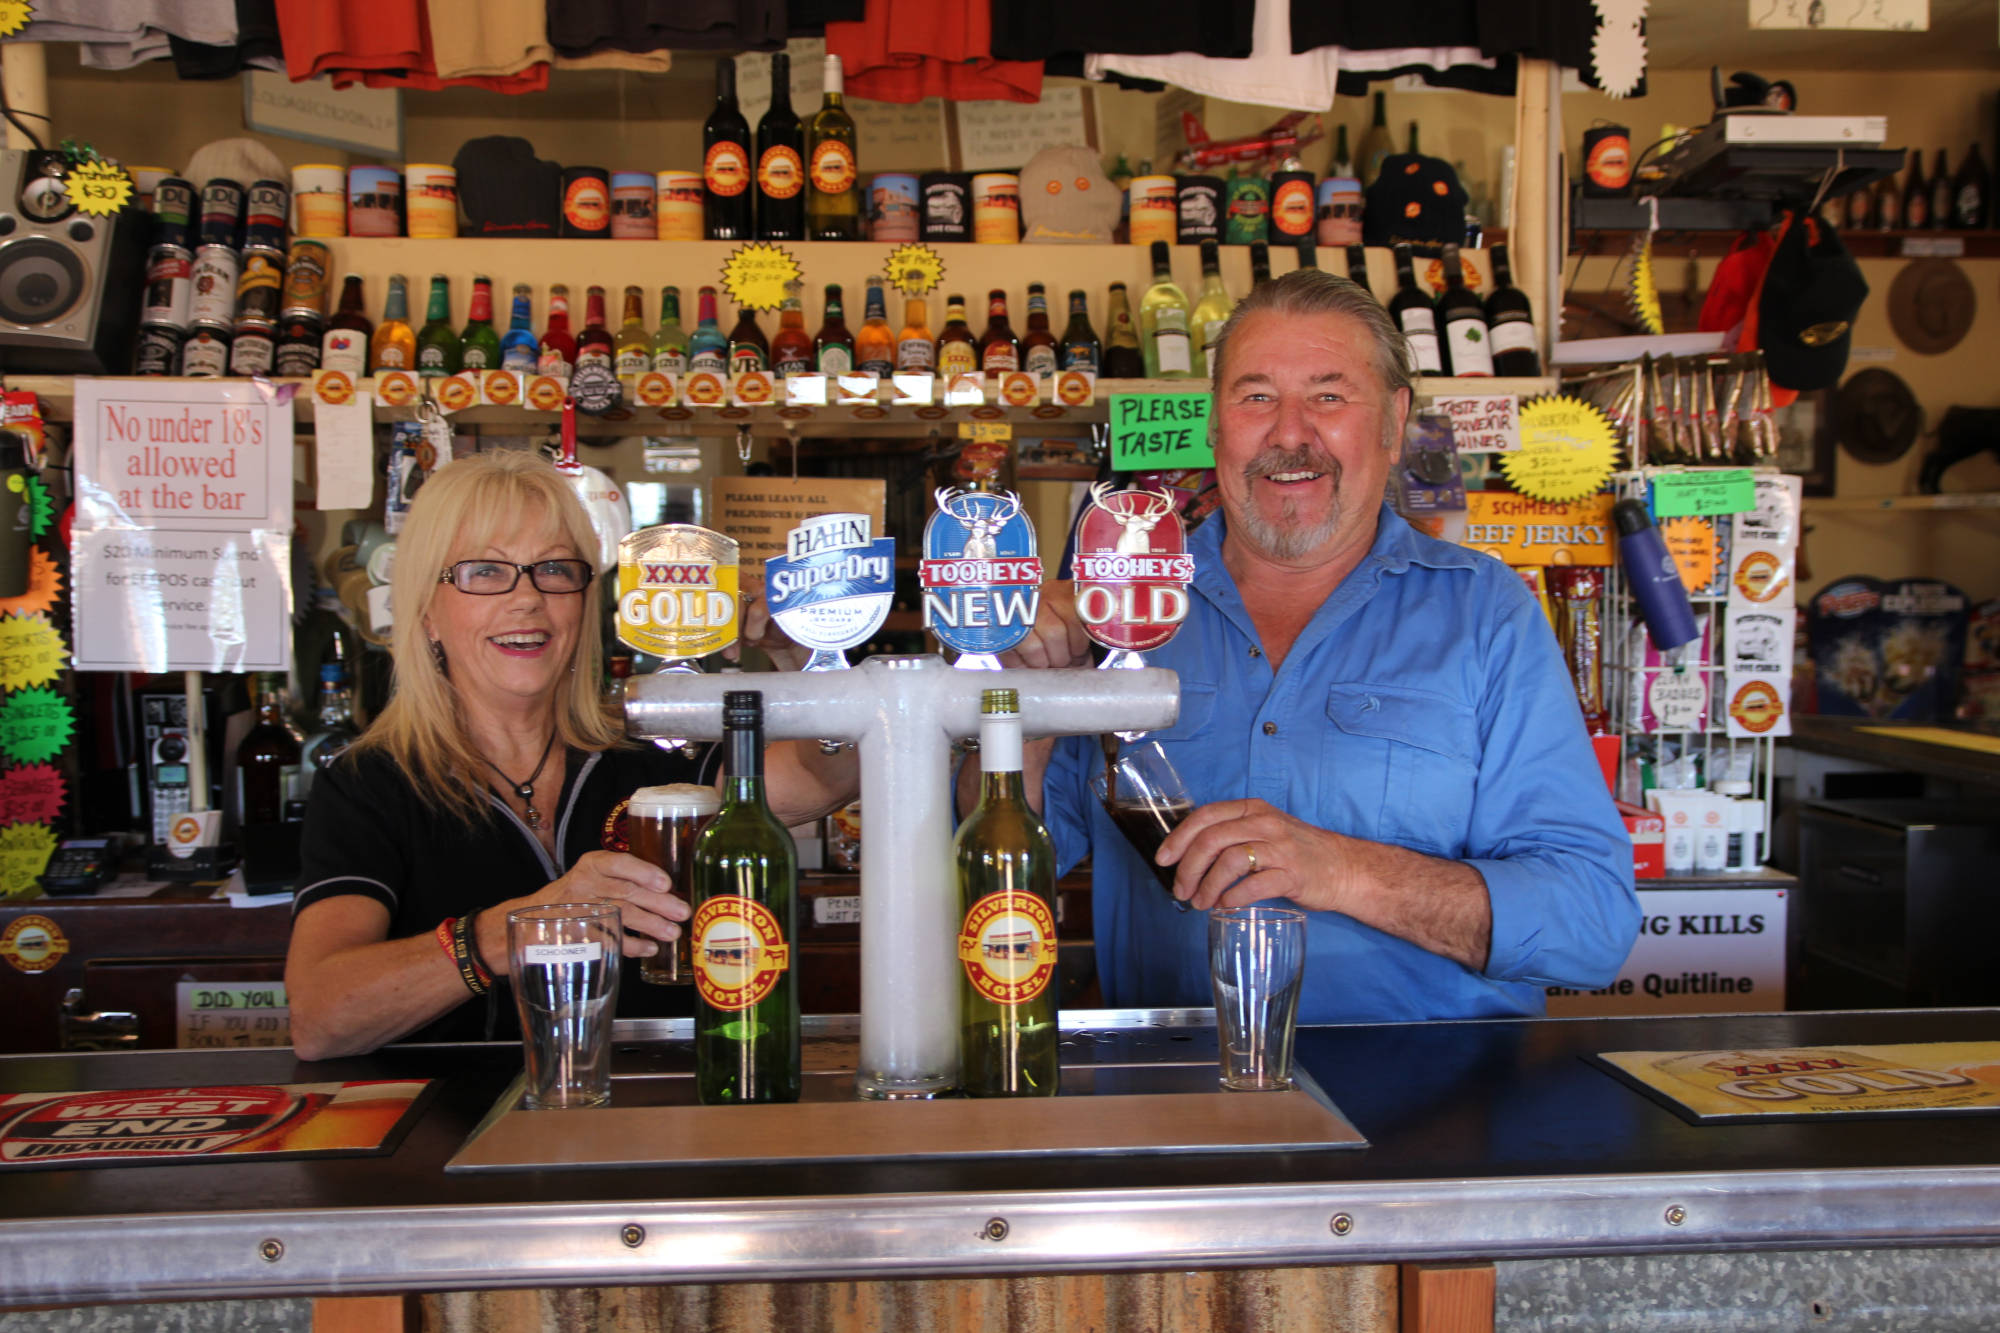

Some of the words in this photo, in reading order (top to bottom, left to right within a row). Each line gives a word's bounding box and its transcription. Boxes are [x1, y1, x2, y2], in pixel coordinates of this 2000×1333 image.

[1118, 398, 1207, 427] PLEASE
[1436, 399, 1481, 417] TASTE
[1485, 398, 1514, 414] OUR
[105, 405, 142, 443] No
[148, 407, 214, 445] under
[221, 408, 263, 446] 18's
[1451, 413, 1512, 433] OUVENIR
[1117, 428, 1193, 457] TASTE
[127, 446, 237, 480] allowed
[118, 487, 143, 510] at
[151, 484, 193, 511] the
[202, 483, 247, 512] bar
[725, 493, 765, 503] PLEASE
[768, 494, 804, 503] LEAVE
[807, 494, 829, 504] ALL
[725, 510, 792, 519] PREJUDICES
[793, 518, 868, 557] HAHN
[1521, 523, 1610, 548] JERKY
[105, 572, 127, 586] for
[645, 564, 712, 585] XXXX
[927, 561, 1037, 583] TOOHEYS
[1080, 557, 1188, 579] TOOHEYS
[156, 599, 208, 613] ervice.
[620, 589, 735, 627] GOLD
[922, 590, 1041, 629] NEW
[1075, 584, 1190, 626] OLD
[694, 901, 778, 940] SILVERTON
[968, 896, 1052, 934] SILVERTON
[1678, 914, 1766, 936] KILLS
[535, 947, 587, 956] SCHOONER
[702, 979, 766, 1003] HOTEL
[978, 975, 1044, 998] HOTEL
[1643, 971, 1754, 998] Quitline
[197, 990, 233, 1008] DID
[240, 990, 275, 1009] YOU
[1722, 1058, 1864, 1078] XXXX
[1717, 1068, 1977, 1102] GOLD
[55, 1099, 270, 1119] WEST
[50, 1117, 228, 1138] END
[13, 1137, 211, 1158] DRAUGHT
